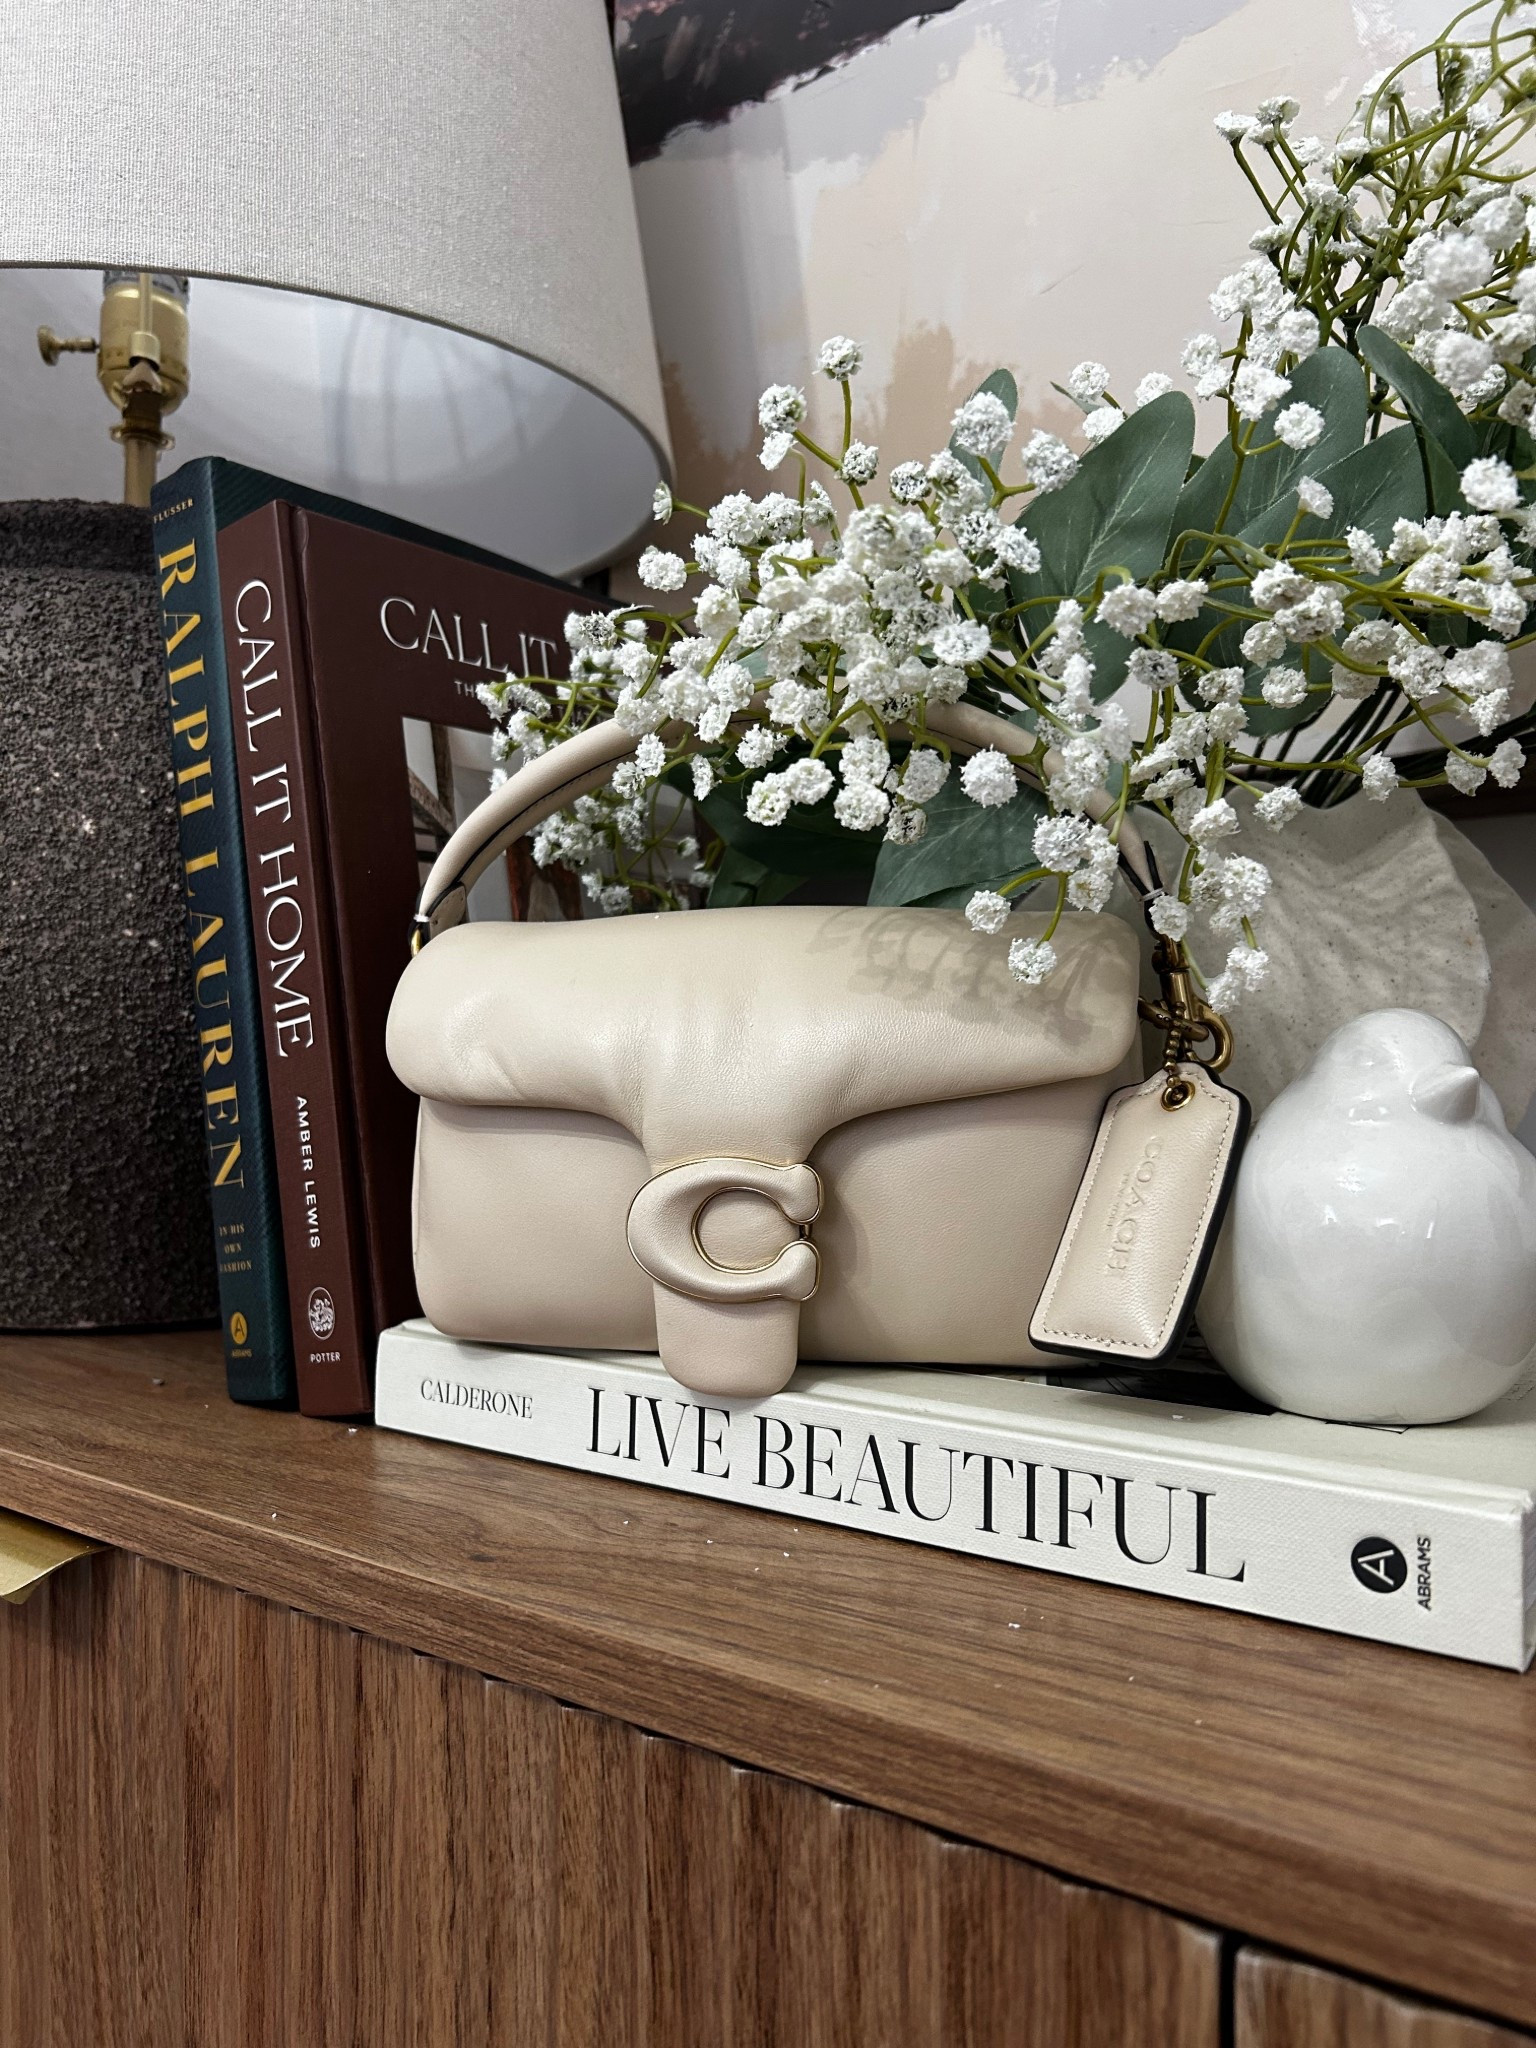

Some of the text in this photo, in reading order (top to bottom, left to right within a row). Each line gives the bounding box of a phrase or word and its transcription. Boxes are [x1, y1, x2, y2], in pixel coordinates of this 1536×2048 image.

[153, 498, 193, 524] FLUSSER
[380, 598, 510, 673] CALL
[519, 633, 558, 678] IT
[159, 537, 245, 1189] RALPH LAUREN
[235, 579, 314, 1058] CALL IT HOME
[296, 1096, 321, 1249] AMBER LEWIS
[1107, 1134, 1164, 1271] COACH
[310, 1351, 341, 1364] POTTER
[420, 1379, 533, 1420] CALDERONE
[586, 1386, 1246, 1584] LIVE BEAUTIFUL
[1416, 1536, 1432, 1612] ABRAMS
